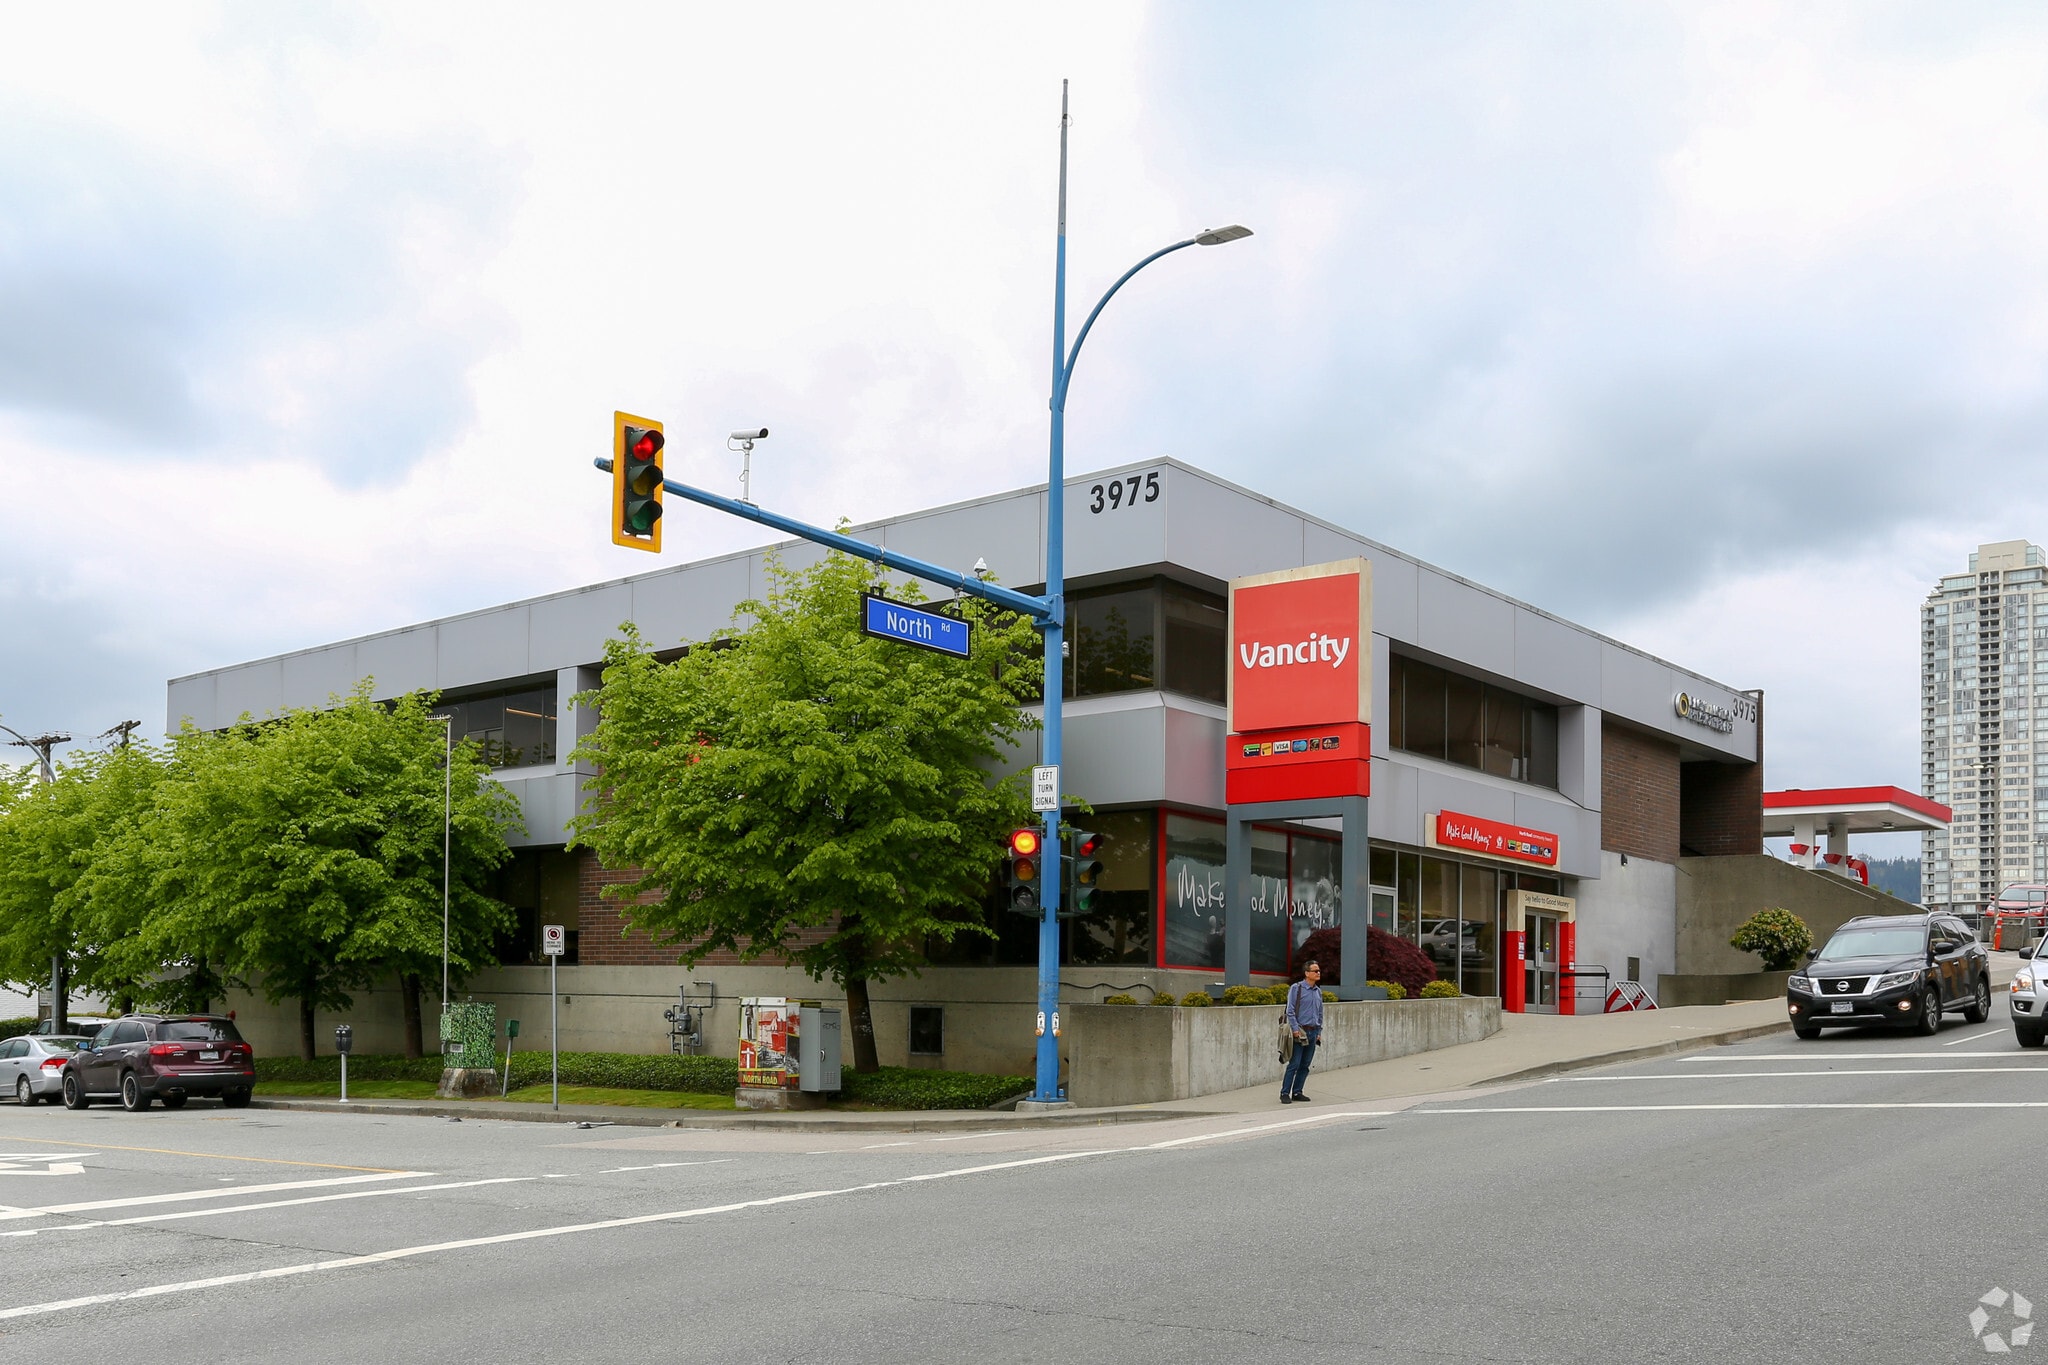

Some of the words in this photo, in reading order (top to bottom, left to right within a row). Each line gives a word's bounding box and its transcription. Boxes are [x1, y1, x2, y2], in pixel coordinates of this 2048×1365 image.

[1090, 472, 1159, 514] 3975
[887, 610, 931, 640] North
[941, 622, 951, 632] Rd
[1240, 632, 1350, 669] Vancity
[1733, 698, 1756, 723] 3975
[1039, 771, 1053, 781] LEFT
[1038, 784, 1054, 793] TURN
[1035, 796, 1056, 806] SIGNAL
[1446, 821, 1460, 840] Make
[1461, 825, 1473, 840] Good
[1178, 864, 1225, 917] Make
[743, 1074, 761, 1084] NORTH
[762, 1075, 777, 1085] ROAD
